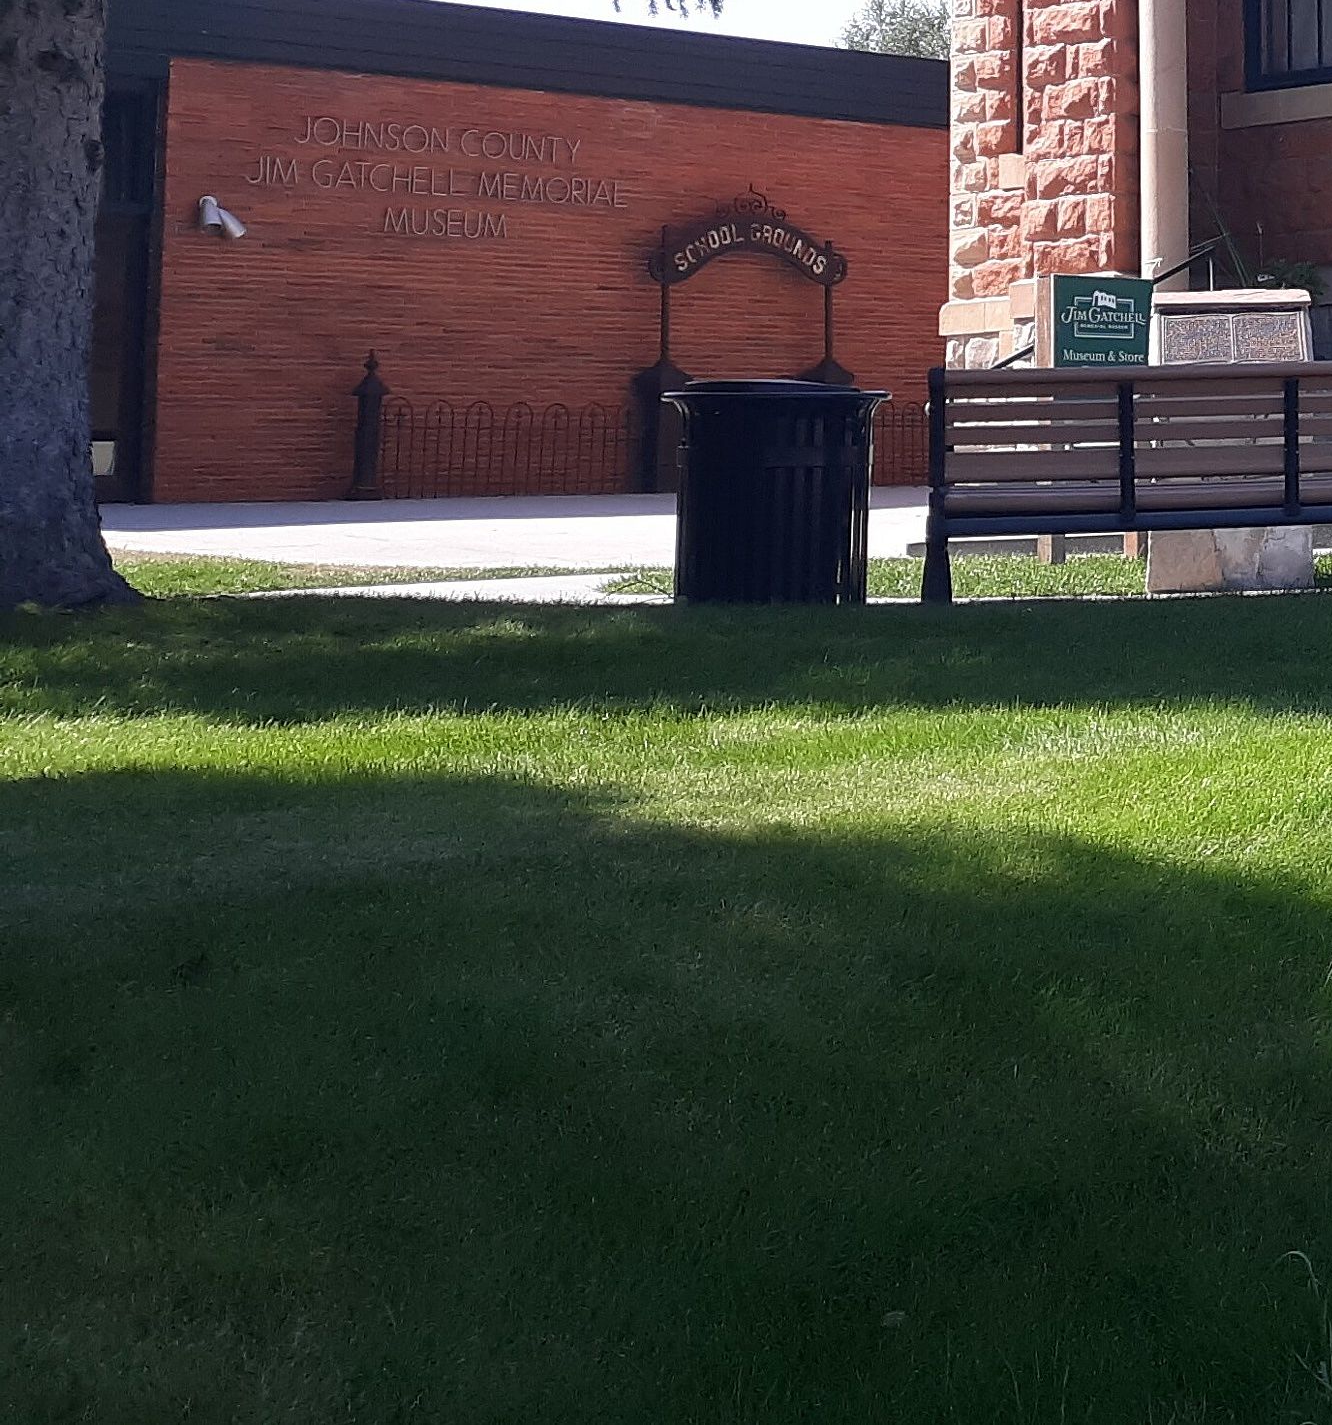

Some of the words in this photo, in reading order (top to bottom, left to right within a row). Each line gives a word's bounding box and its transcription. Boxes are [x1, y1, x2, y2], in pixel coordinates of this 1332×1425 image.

[294, 116, 449, 154] JOHNSON
[460, 129, 581, 164] COUNTY
[246, 155, 299, 186] JIM
[312, 159, 466, 197] GATCHELL
[478, 171, 628, 208] MEMORIAL
[383, 206, 508, 239] MUSEUM
[674, 224, 745, 272] SCHOOL
[750, 223, 827, 274] GROUNDS
[1061, 306, 1087, 324] JIM
[1088, 306, 1146, 325] GATCHELL
[1063, 349, 1105, 362] Museum
[1107, 350, 1116, 362] &
[1118, 350, 1144, 362] Store
